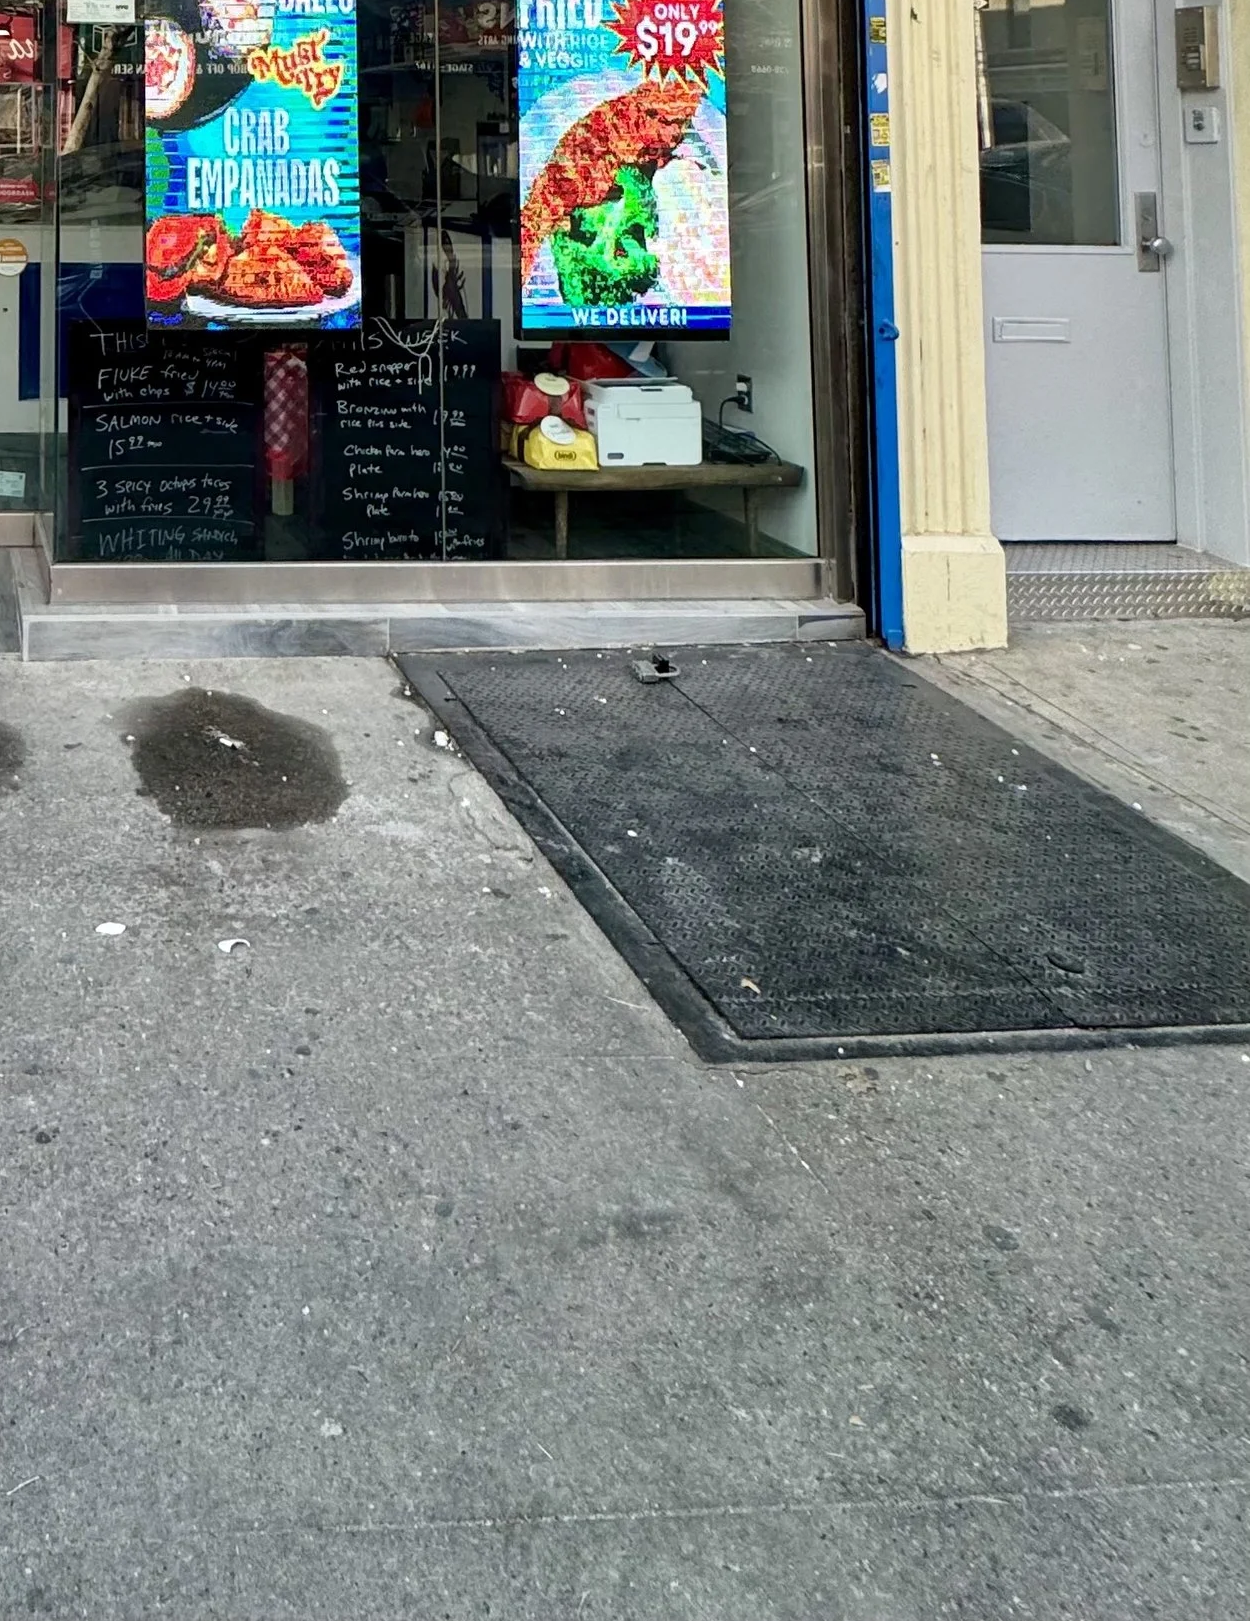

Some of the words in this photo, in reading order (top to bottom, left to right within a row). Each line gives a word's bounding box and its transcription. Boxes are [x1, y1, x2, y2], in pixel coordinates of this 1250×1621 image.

[654, 2, 700, 20] ONLY
[535, 51, 610, 69] VEGGIES
[224, 107, 290, 155] CRAB
[187, 157, 340, 208] EMPANADAS
[571, 308, 600, 326] WE
[335, 360, 367, 378] Red
[96, 414, 161, 432] SALMON
